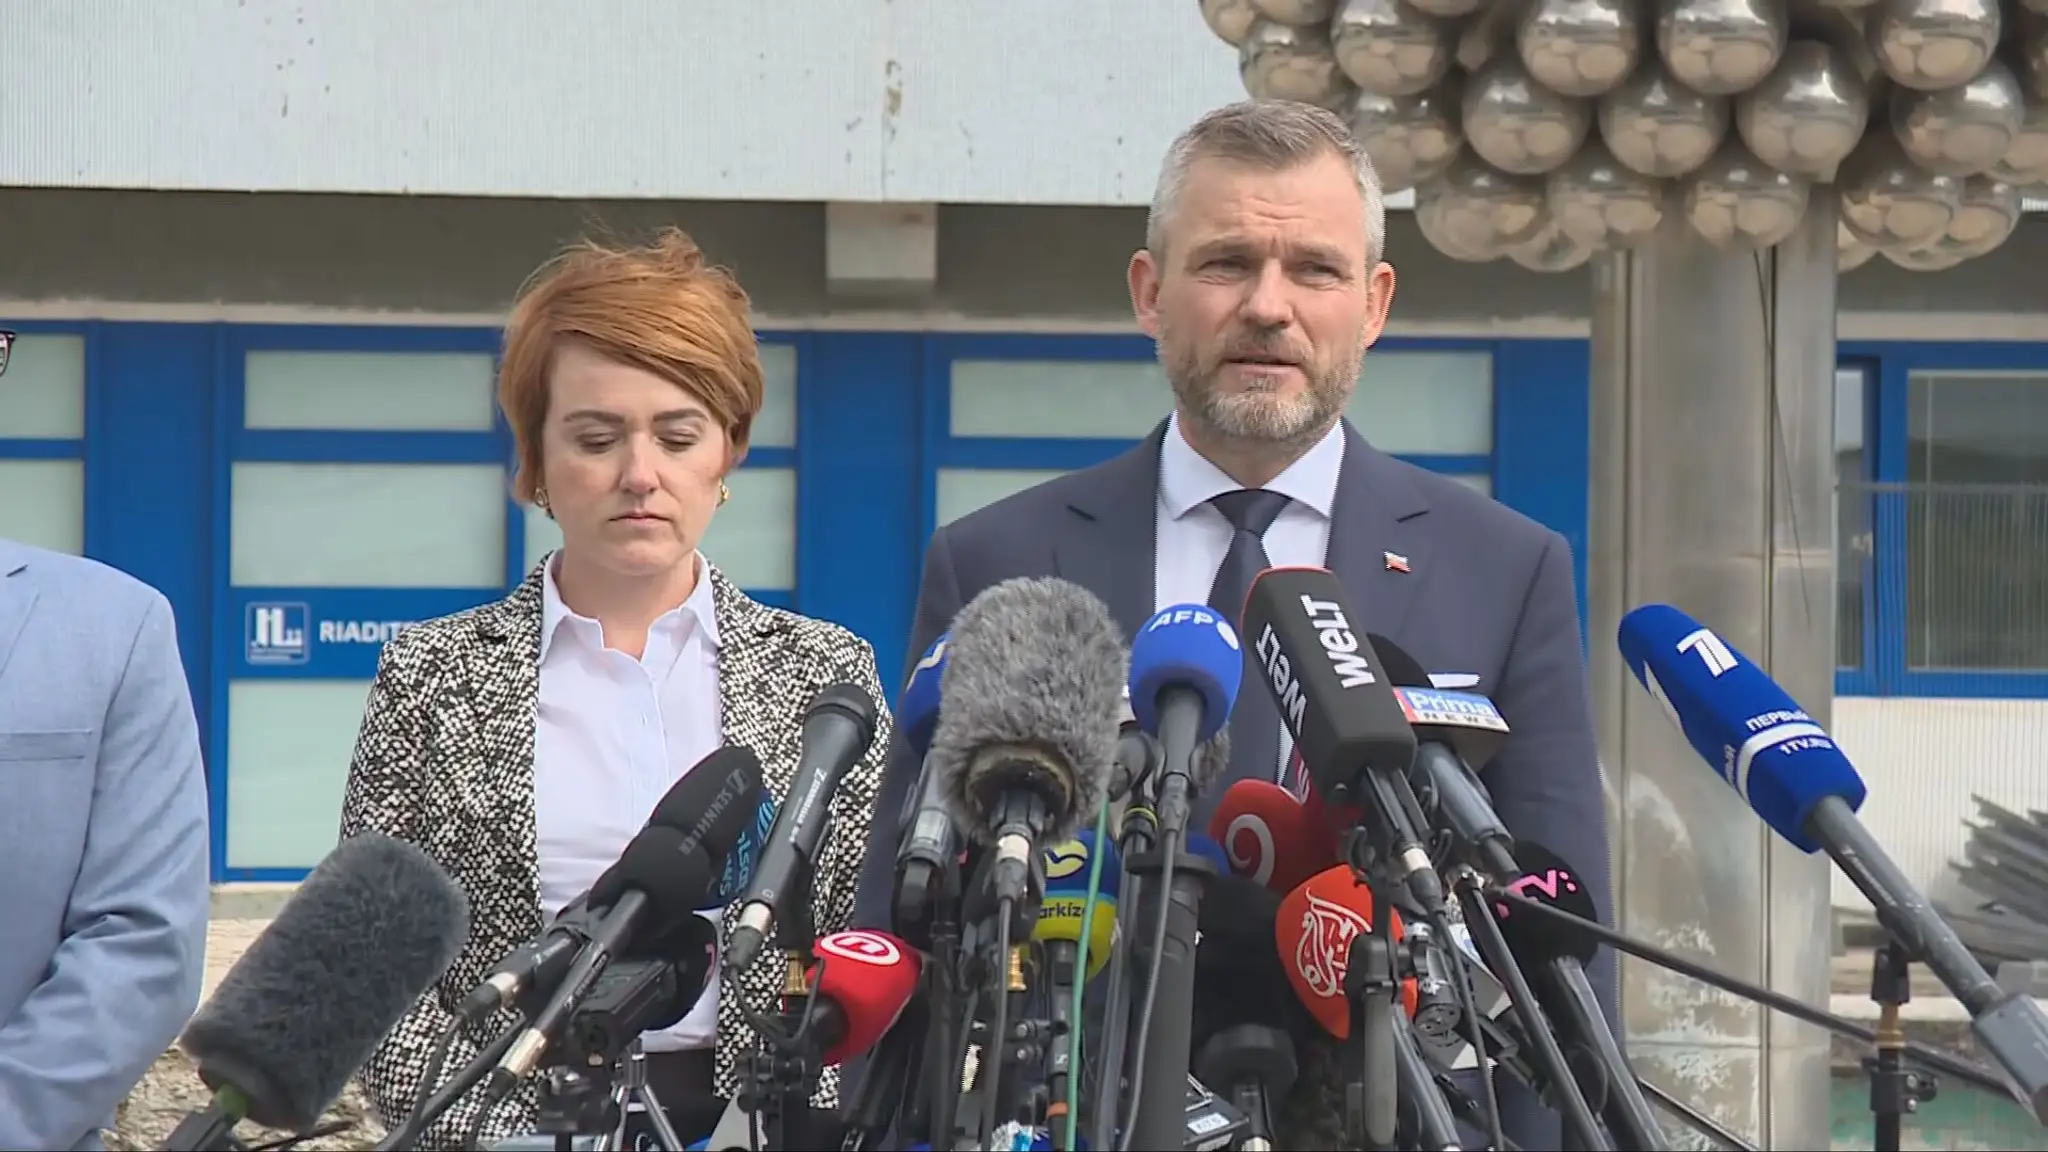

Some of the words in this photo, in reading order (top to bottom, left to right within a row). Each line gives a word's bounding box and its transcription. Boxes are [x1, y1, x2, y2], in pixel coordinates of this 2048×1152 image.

[1147, 609, 1214, 633] AFP
[1406, 690, 1499, 719] Prima
[1422, 711, 1502, 726] NEWS
[1039, 902, 1086, 919] arkíz
